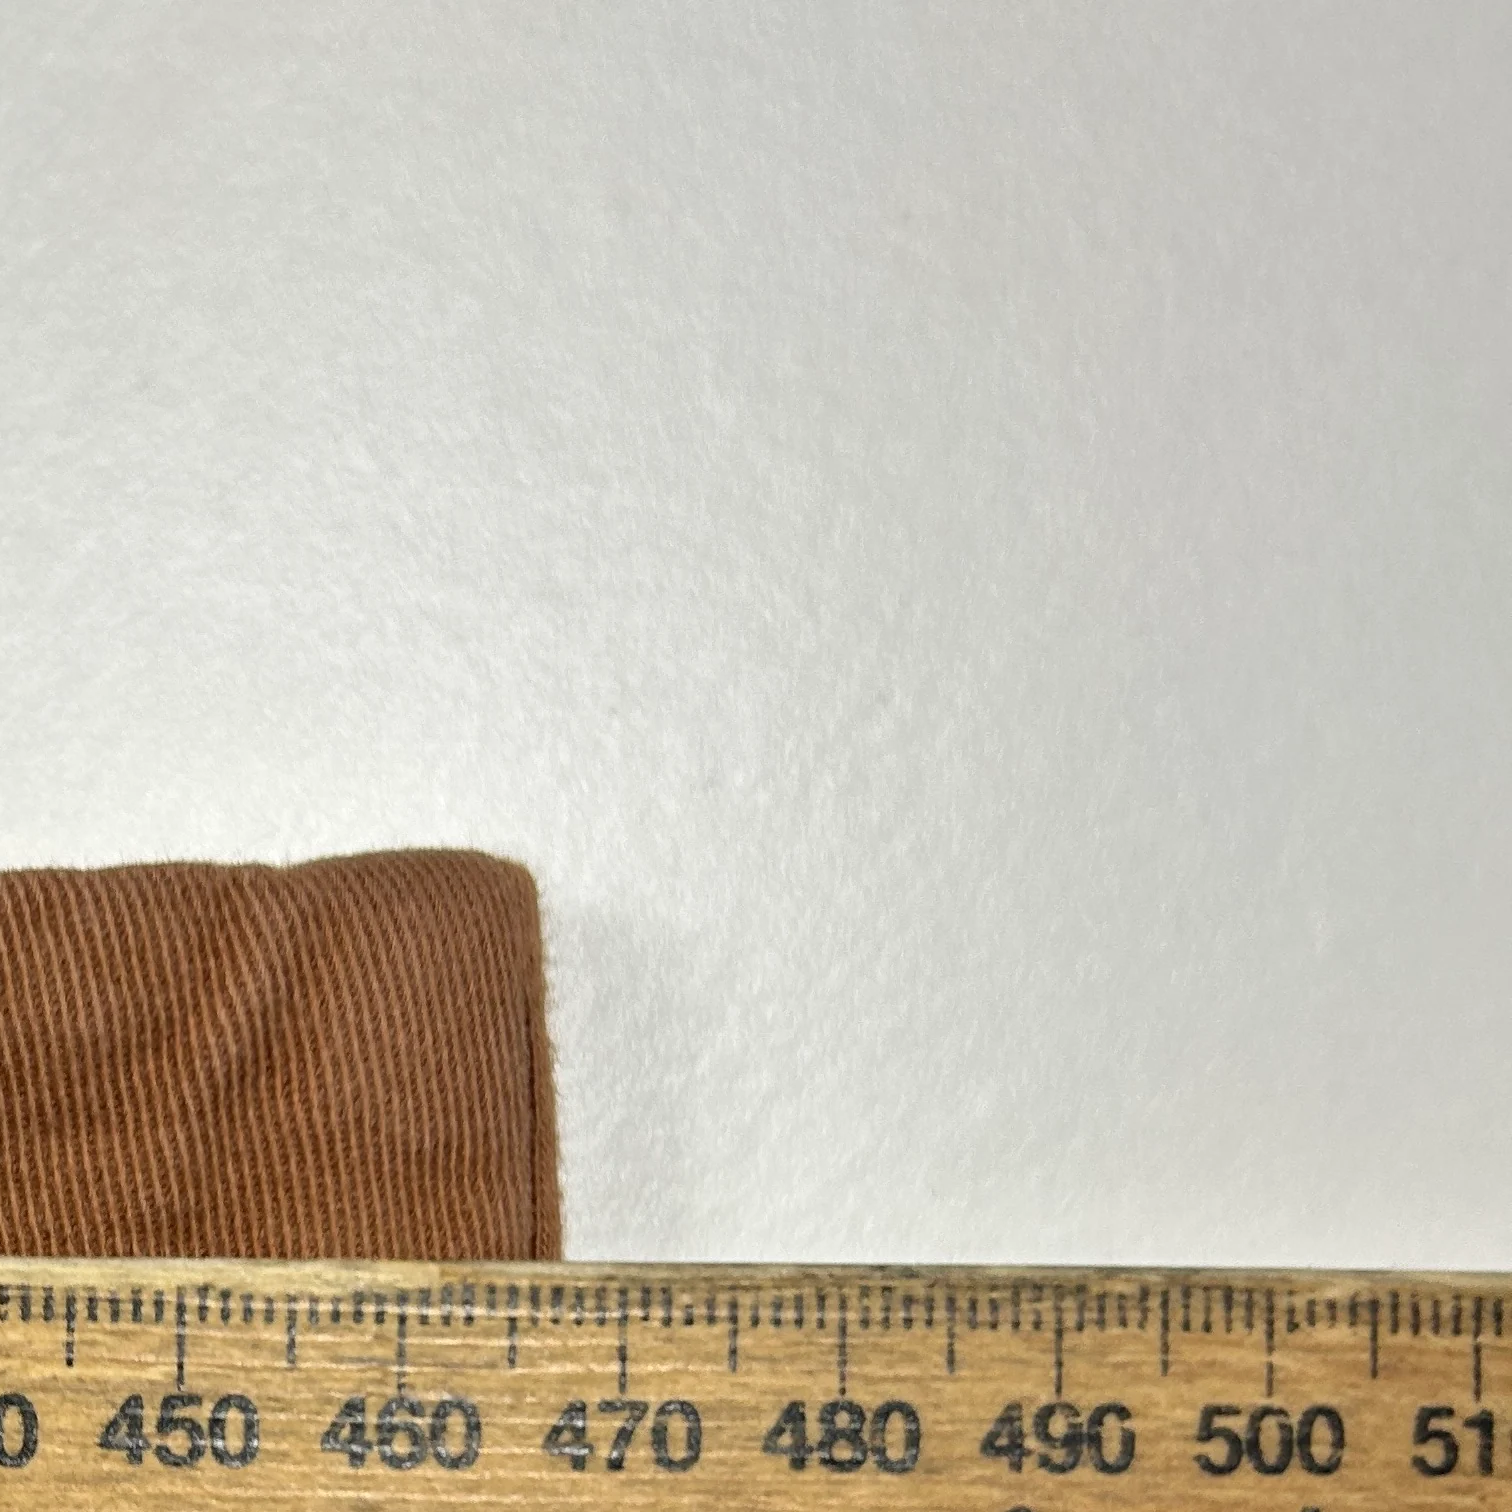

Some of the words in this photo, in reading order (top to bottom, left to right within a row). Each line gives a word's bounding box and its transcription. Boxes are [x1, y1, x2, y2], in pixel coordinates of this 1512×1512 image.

[98, 1392, 261, 1468] 450
[320, 1394, 482, 1470] 460
[544, 1397, 703, 1472] 470
[764, 1398, 922, 1474] 480
[980, 1400, 1136, 1474] 490
[1195, 1402, 1346, 1476] 500
[1412, 1402, 1512, 1477] 51
